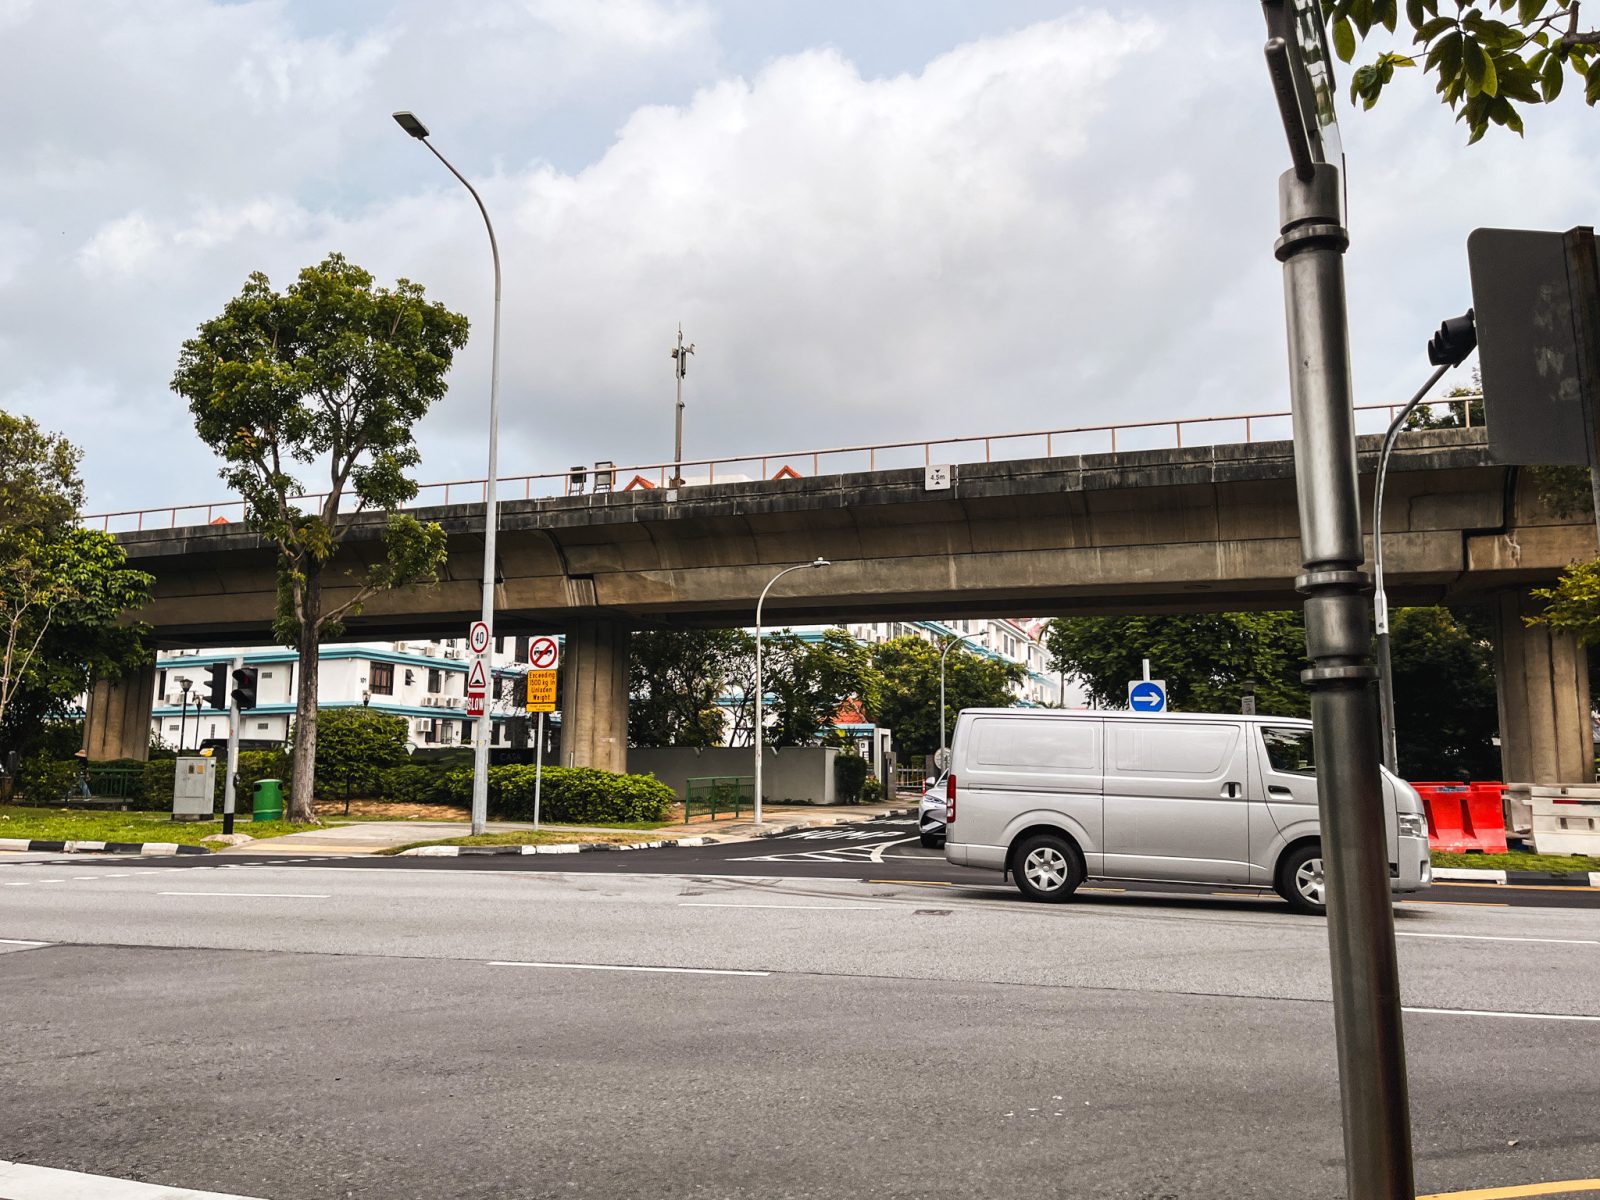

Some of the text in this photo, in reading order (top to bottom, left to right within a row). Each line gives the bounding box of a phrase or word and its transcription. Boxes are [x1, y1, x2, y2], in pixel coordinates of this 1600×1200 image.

[475, 632, 484, 644] 40
[542, 679, 549, 687] kg
[533, 694, 551, 702] Weight
[467, 698, 484, 710] SLOW
